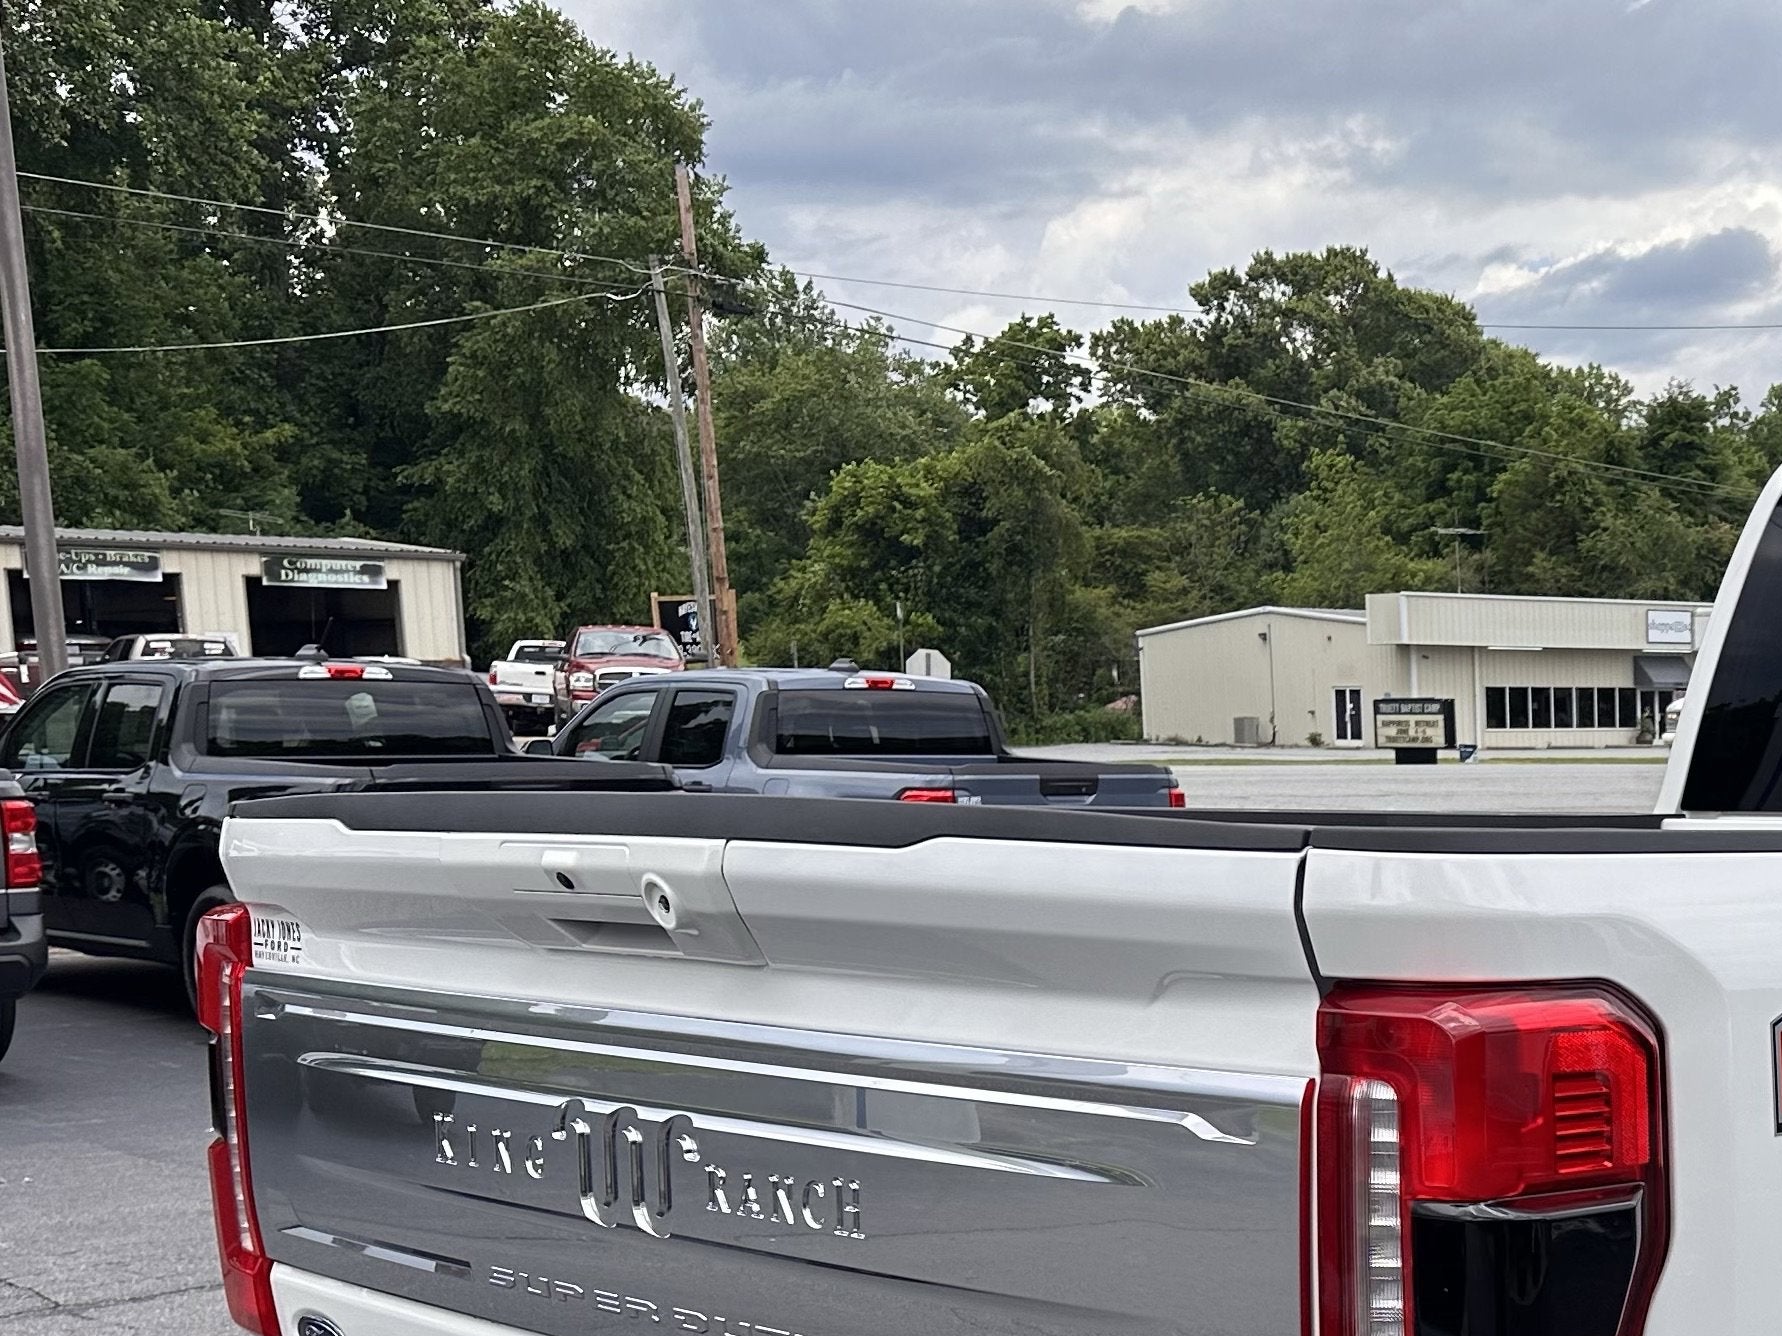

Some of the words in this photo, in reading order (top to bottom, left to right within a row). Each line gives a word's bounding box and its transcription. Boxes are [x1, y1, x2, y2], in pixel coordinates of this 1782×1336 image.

[58, 550, 95, 562] e-Ups
[106, 551, 150, 562] Brakes
[87, 564, 131, 576] Repair
[282, 557, 361, 572] Computer
[281, 569, 370, 584] Diagnostics
[254, 917, 275, 939] JACKY
[277, 920, 301, 942] JONES
[265, 939, 288, 952] FORD
[433, 1111, 545, 1179] KING
[705, 1163, 866, 1240] RANCH
[488, 1265, 661, 1323] SUPER
